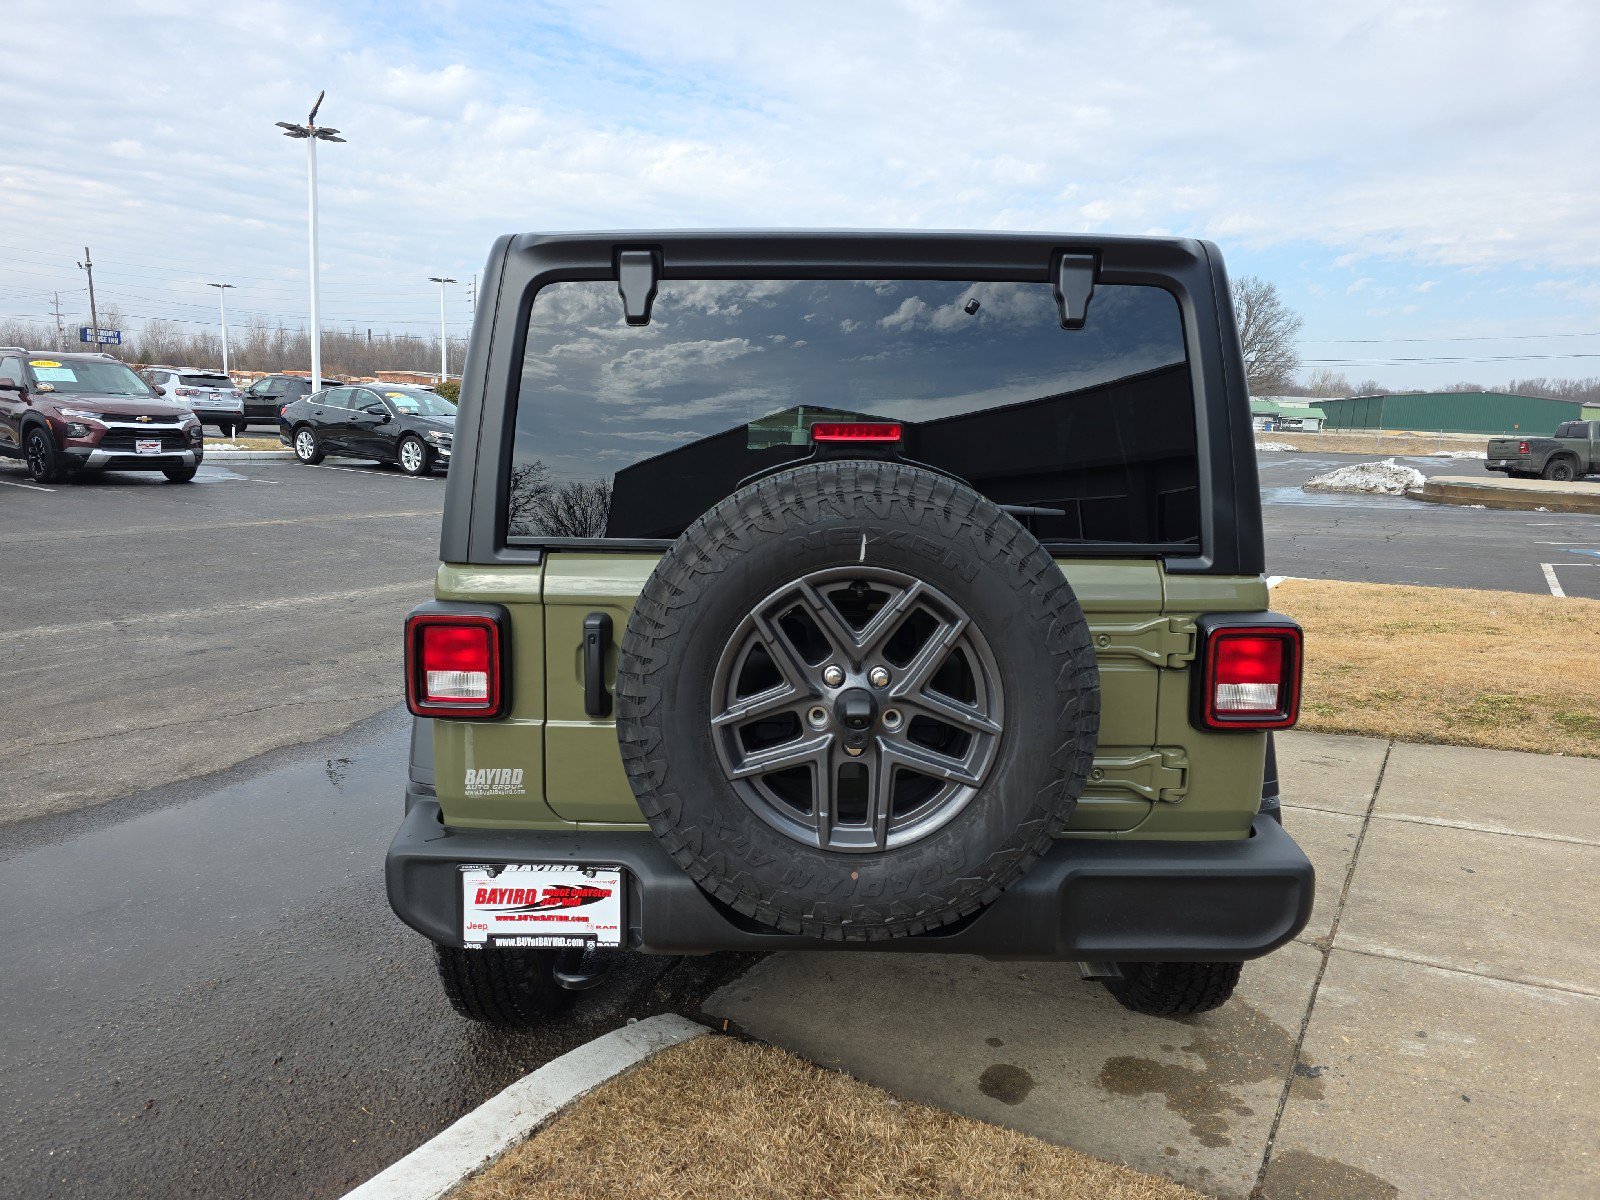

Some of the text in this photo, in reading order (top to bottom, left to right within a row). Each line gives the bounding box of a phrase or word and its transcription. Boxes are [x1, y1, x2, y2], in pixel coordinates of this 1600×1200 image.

[788, 526, 983, 584] NEXEN
[465, 768, 524, 785] BAYIRD
[504, 864, 580, 872] BAYIRD
[474, 888, 538, 905] BAYIRD
[541, 888, 613, 898] DODGE CHRYSLER
[540, 897, 582, 906] JEEP RAM
[466, 922, 489, 931] Jeep
[495, 937, 585, 947] www.BUYatBAYIRD.com
